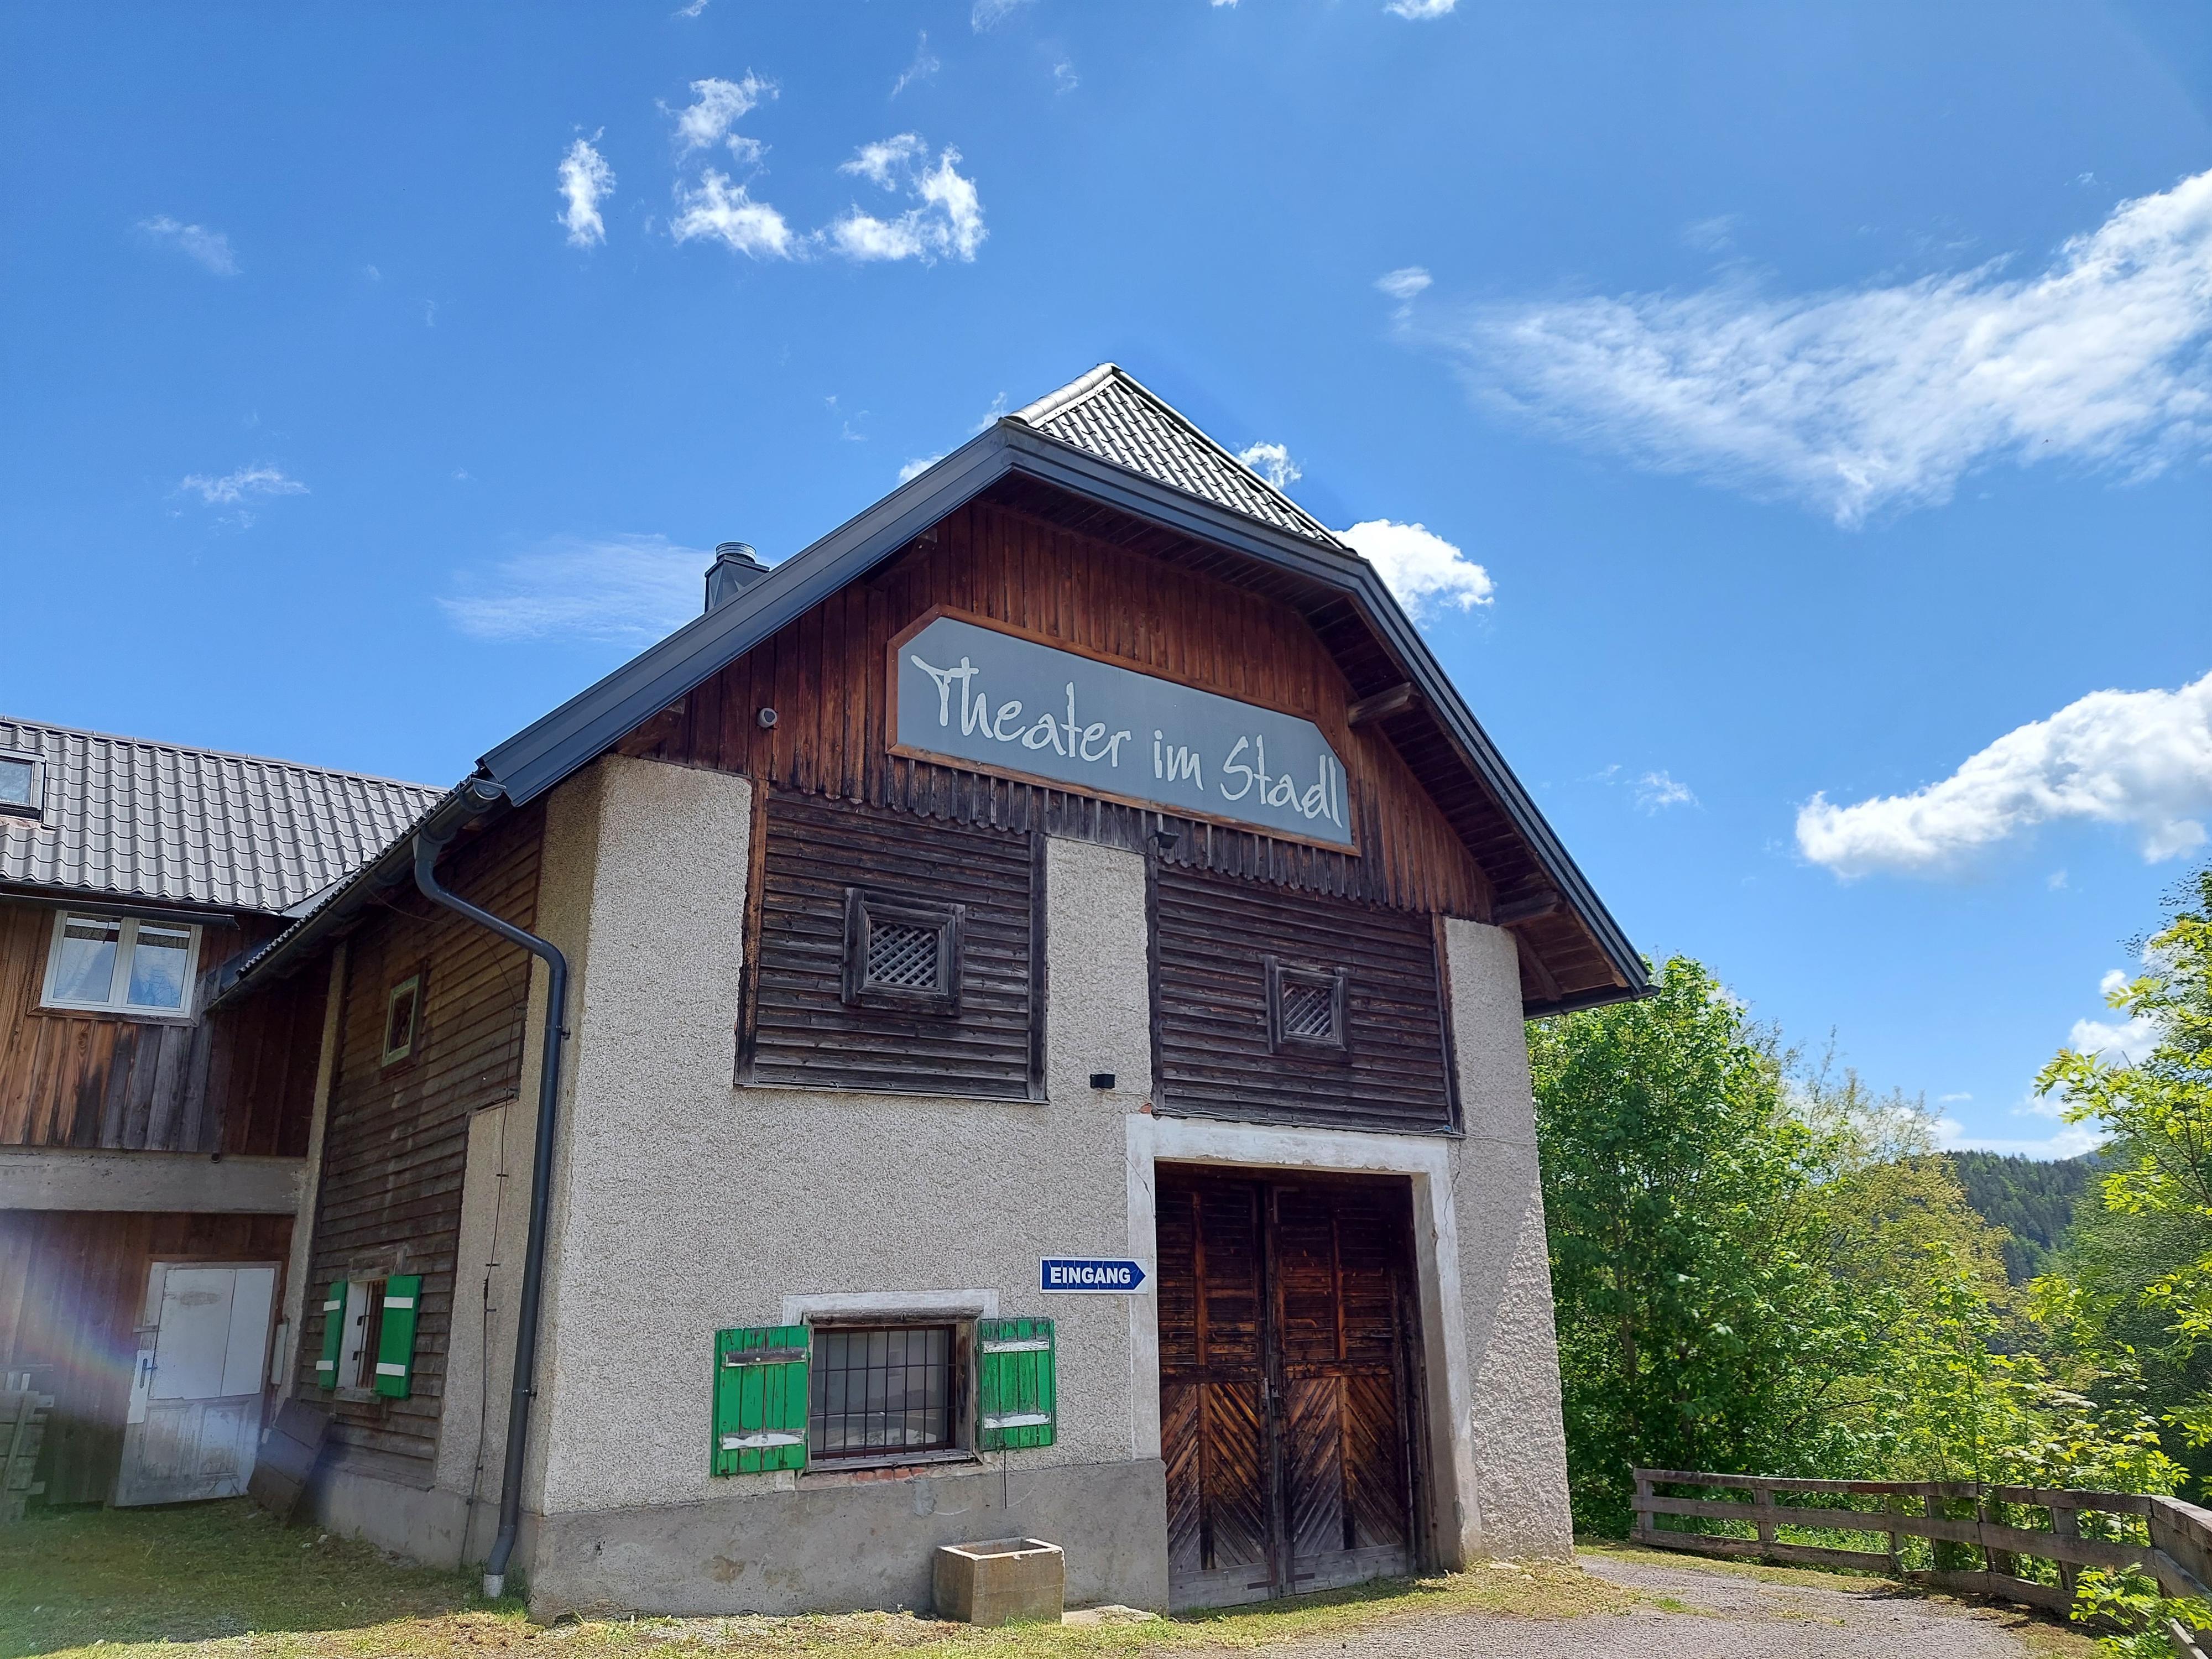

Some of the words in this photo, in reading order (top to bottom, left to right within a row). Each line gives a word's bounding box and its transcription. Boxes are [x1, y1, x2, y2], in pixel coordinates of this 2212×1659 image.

[910, 654, 1131, 768] Theater
[1153, 729, 1204, 791] im
[1220, 734, 1343, 828] Stadl
[1050, 1266, 1131, 1284] EINGANG
